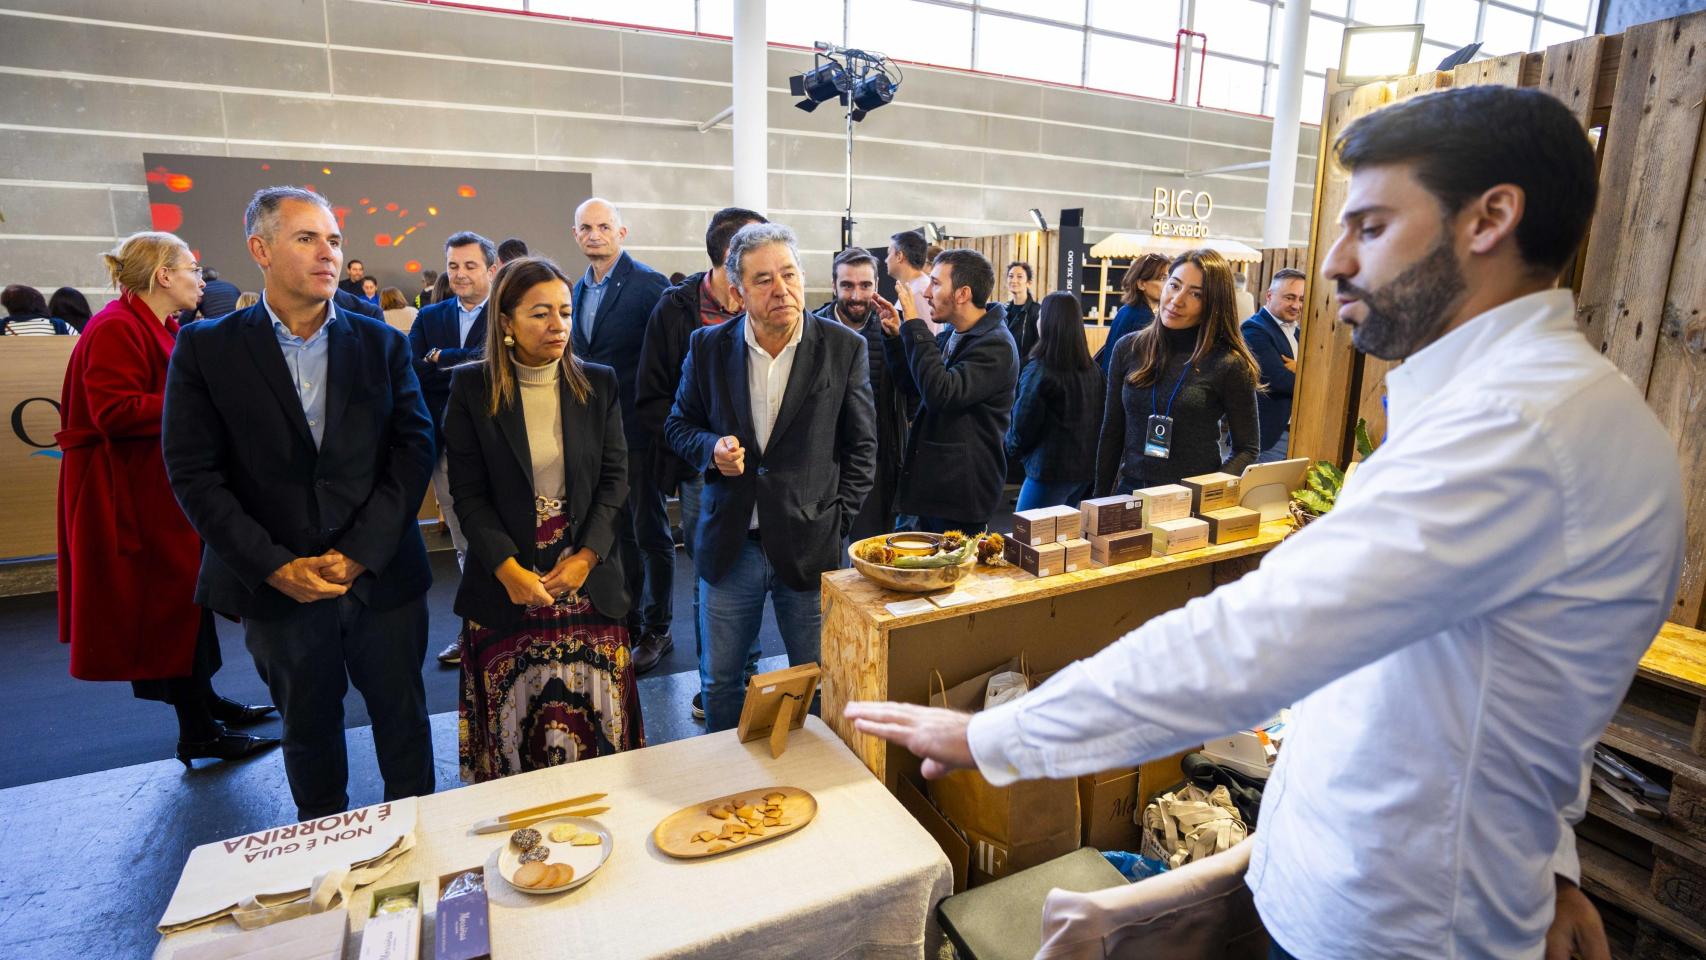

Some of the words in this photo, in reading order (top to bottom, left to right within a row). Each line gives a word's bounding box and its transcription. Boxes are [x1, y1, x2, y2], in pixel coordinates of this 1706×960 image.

[1153, 187, 1212, 220] BICO
[1152, 219, 1169, 235] de
[1171, 221, 1208, 238] xeado
[1066, 279, 1073, 290] DE
[377, 803, 392, 822] É
[223, 808, 369, 854] MORRIÑA
[323, 825, 373, 845] NON
[244, 842, 301, 864] GULA
[305, 838, 317, 852] É
